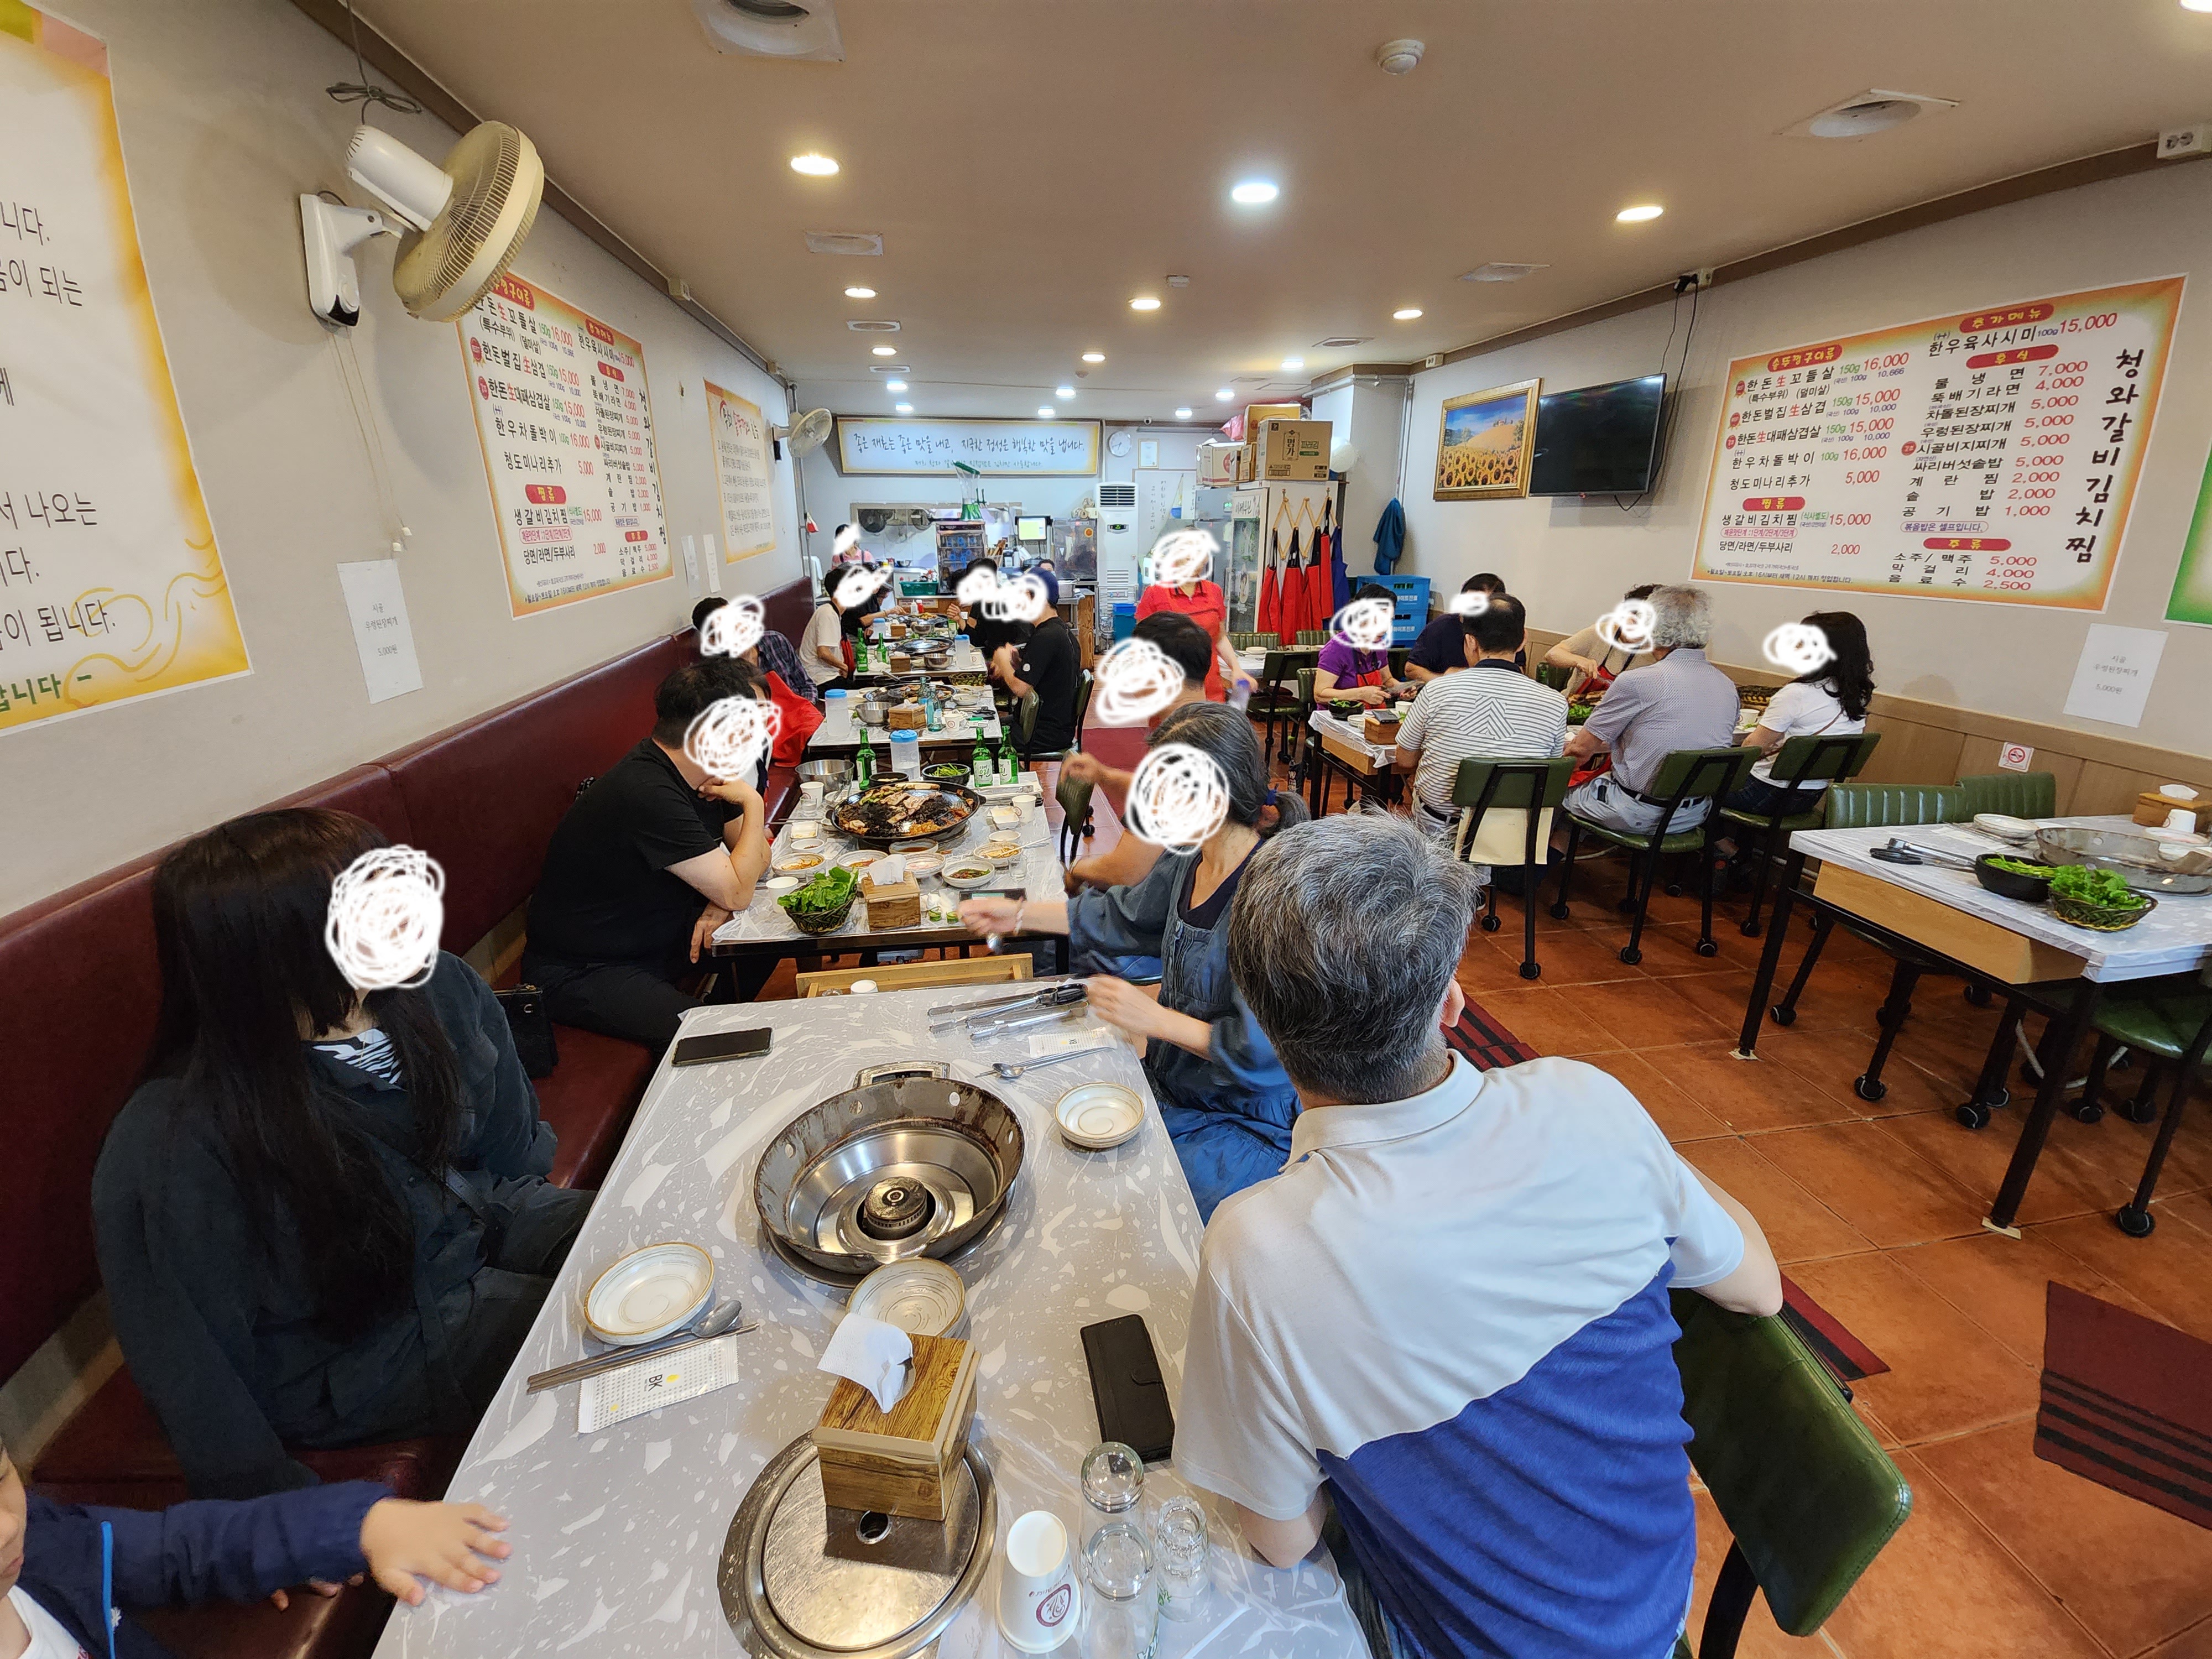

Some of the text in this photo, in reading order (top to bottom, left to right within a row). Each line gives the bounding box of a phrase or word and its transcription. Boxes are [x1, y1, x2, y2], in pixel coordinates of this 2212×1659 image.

[40, 266, 82, 307] 되는
[1972, 308, 2041, 328] 추가메뉴
[1840, 364, 1861, 374] 150g
[1864, 352, 1909, 371] 16,000
[1749, 384, 1830, 404] (특수부위) (덜미살)
[1833, 397, 1853, 407] 150g
[1856, 388, 1901, 405] 15,000
[1926, 401, 2016, 420] 차돌된장찌개
[1738, 425, 1821, 446] 한돈生대패삼겹살
[1826, 424, 1846, 434] 150g
[1850, 418, 1894, 434] 15,000
[1921, 420, 2012, 439] 우렁된장찌개
[854, 433, 1085, 455] 좋은 재료는 좋은 맛을 내고, 지극한 정성은 행복한 맛을 냅니다.
[1821, 452, 1839, 461] 100g
[1844, 446, 1887, 461] 16,000
[1916, 437, 2008, 455] 시골비지찌개
[1913, 457, 2004, 472] 싸리버섯솥밥
[1730, 470, 1880, 491] 청도미나리추가 5,000
[2012, 471, 2060, 484] 2,000
[2007, 488, 2056, 500] 2,000
[24, 491, 97, 528] 나오는
[1830, 513, 1871, 526] 15,000
[1939, 523, 1984, 532] 셀프입니다.
[1719, 541, 1860, 555] 당면/라면/두부사리 2,000
[0, 599, 116, 650] 이 됩니다.
[648, 1374, 663, 1392] BK
